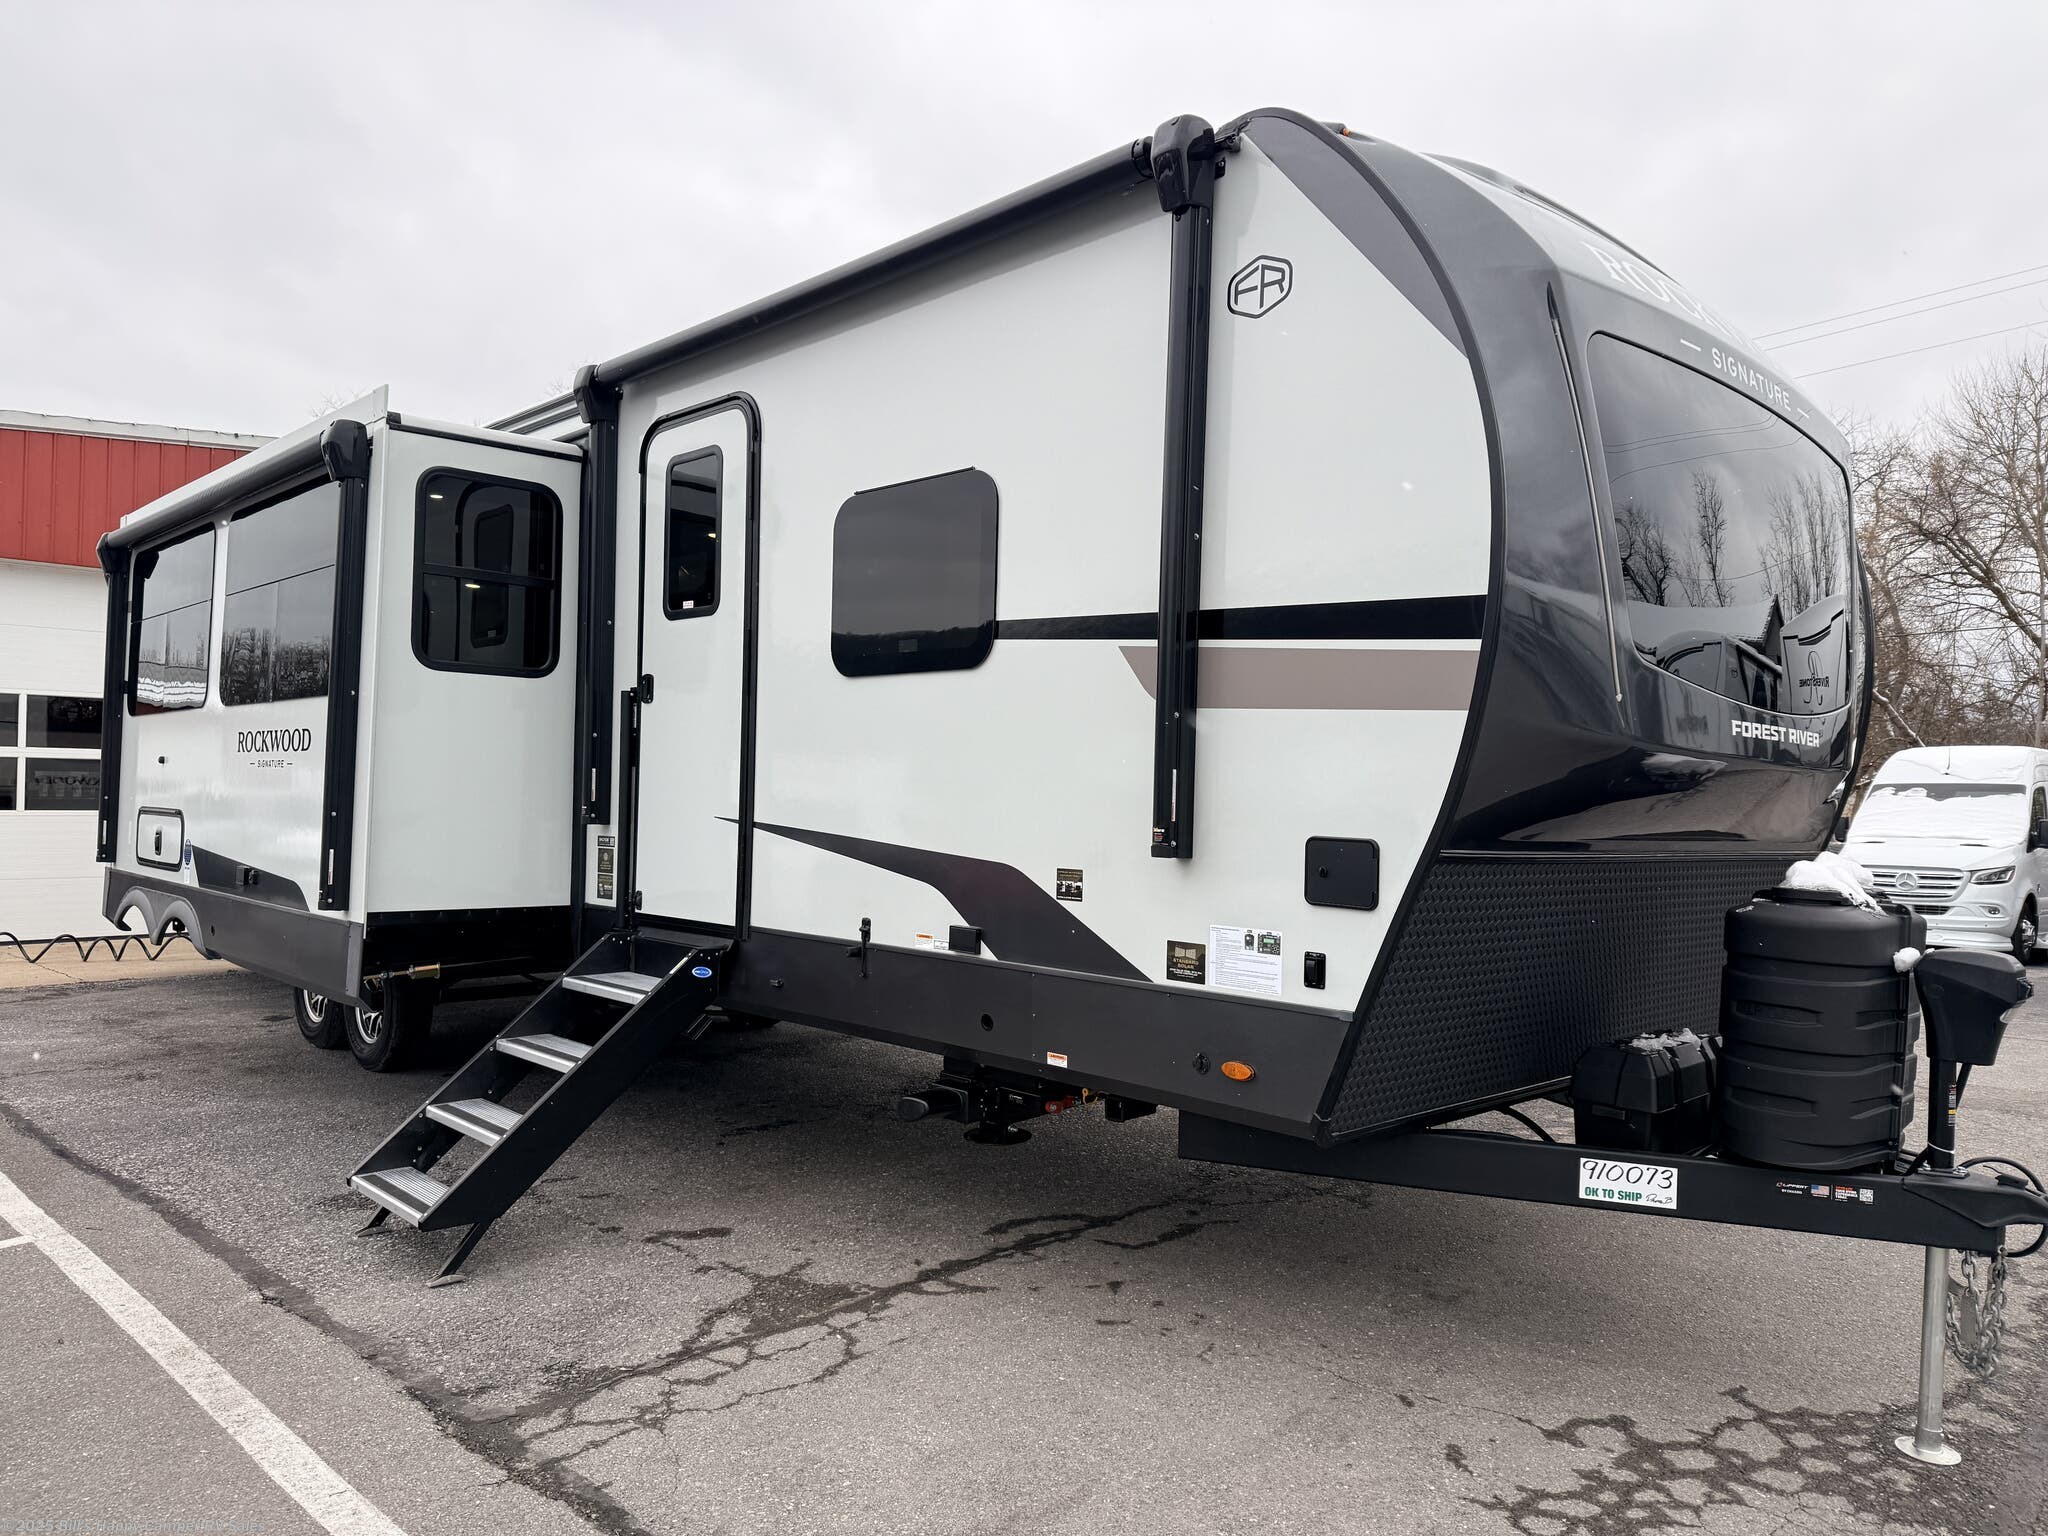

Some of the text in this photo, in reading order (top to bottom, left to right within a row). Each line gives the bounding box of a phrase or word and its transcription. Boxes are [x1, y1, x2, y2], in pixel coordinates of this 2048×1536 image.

[1711, 347, 1791, 411] SIGNATURE
[237, 728, 312, 753] ROCKWOOD
[1731, 719, 1787, 743] FOREST
[1788, 728, 1820, 748] RIVER
[257, 759, 285, 769] SIGNATURE
[1582, 1160, 1674, 1189] 910073
[1584, 1186, 1643, 1202] OK TO SHIP
